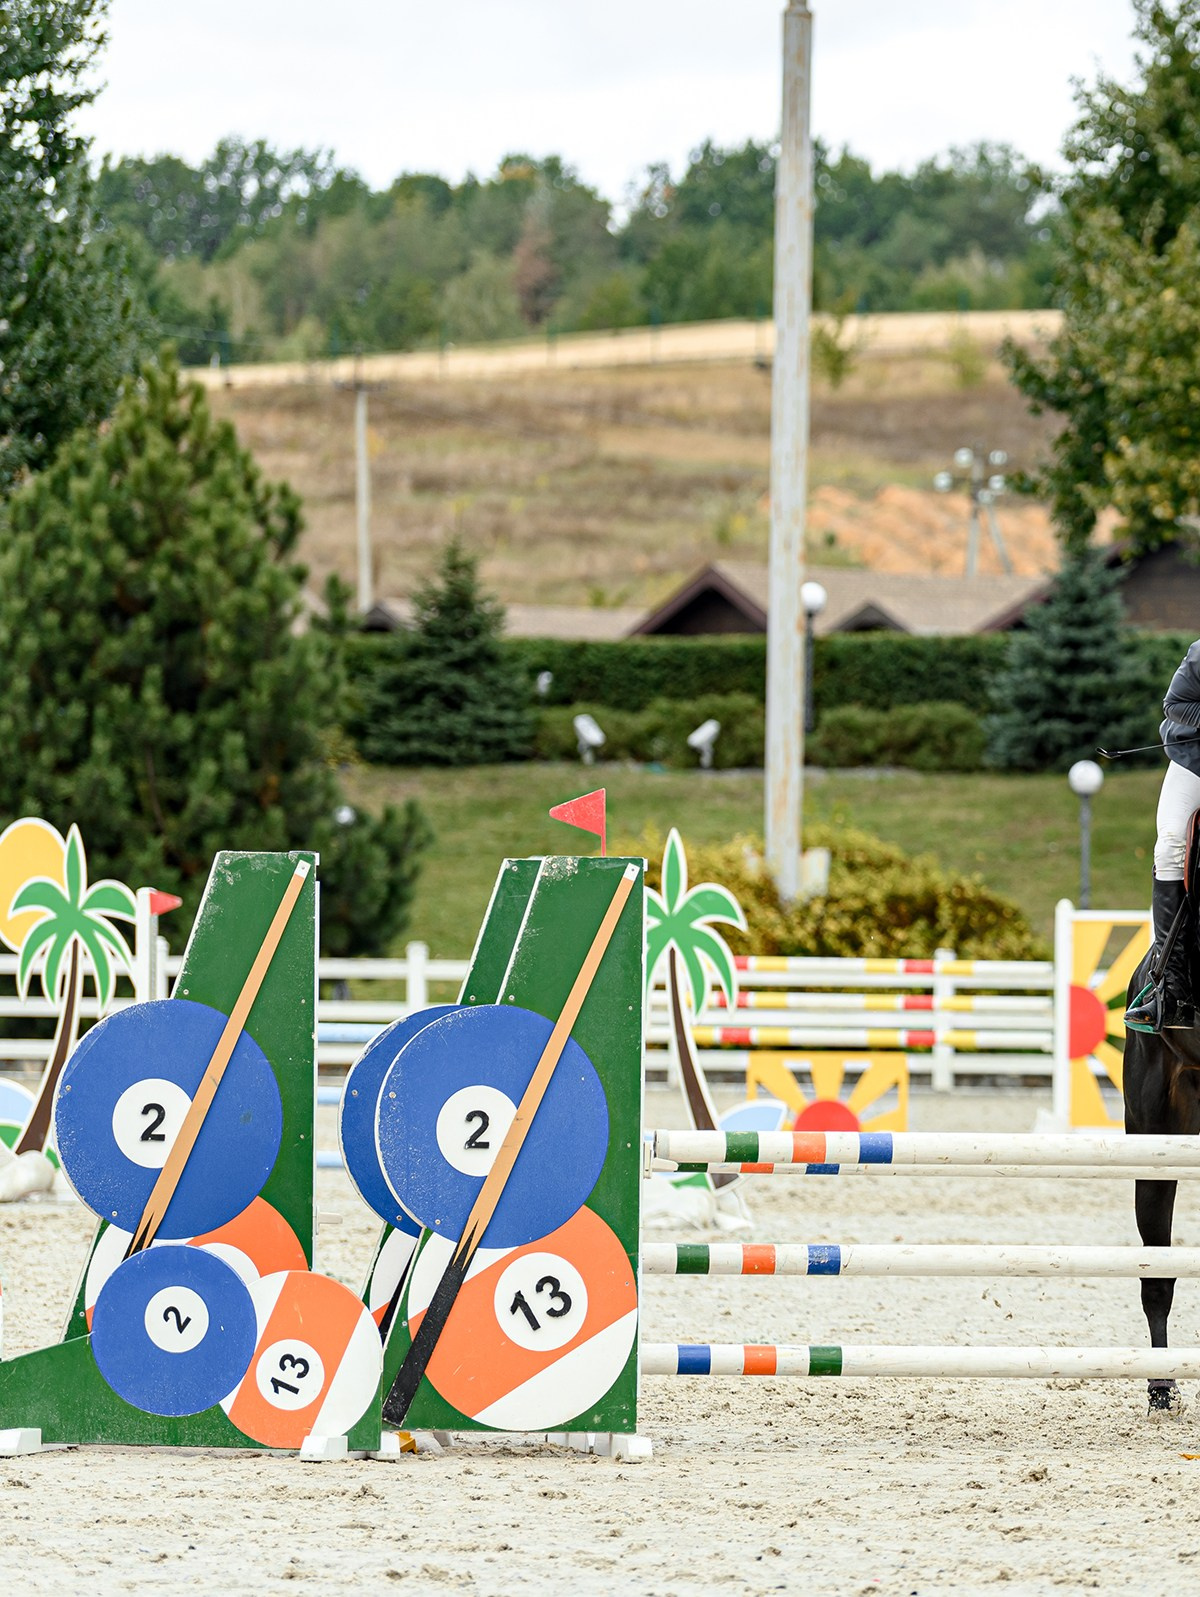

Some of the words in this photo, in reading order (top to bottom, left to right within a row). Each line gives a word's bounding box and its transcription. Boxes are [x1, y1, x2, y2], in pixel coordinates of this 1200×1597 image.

[140, 1103, 166, 1142] 2
[465, 1110, 490, 1149] 2
[163, 1306, 192, 1334] 2
[510, 1275, 572, 1331] 13
[270, 1353, 310, 1395] 13
